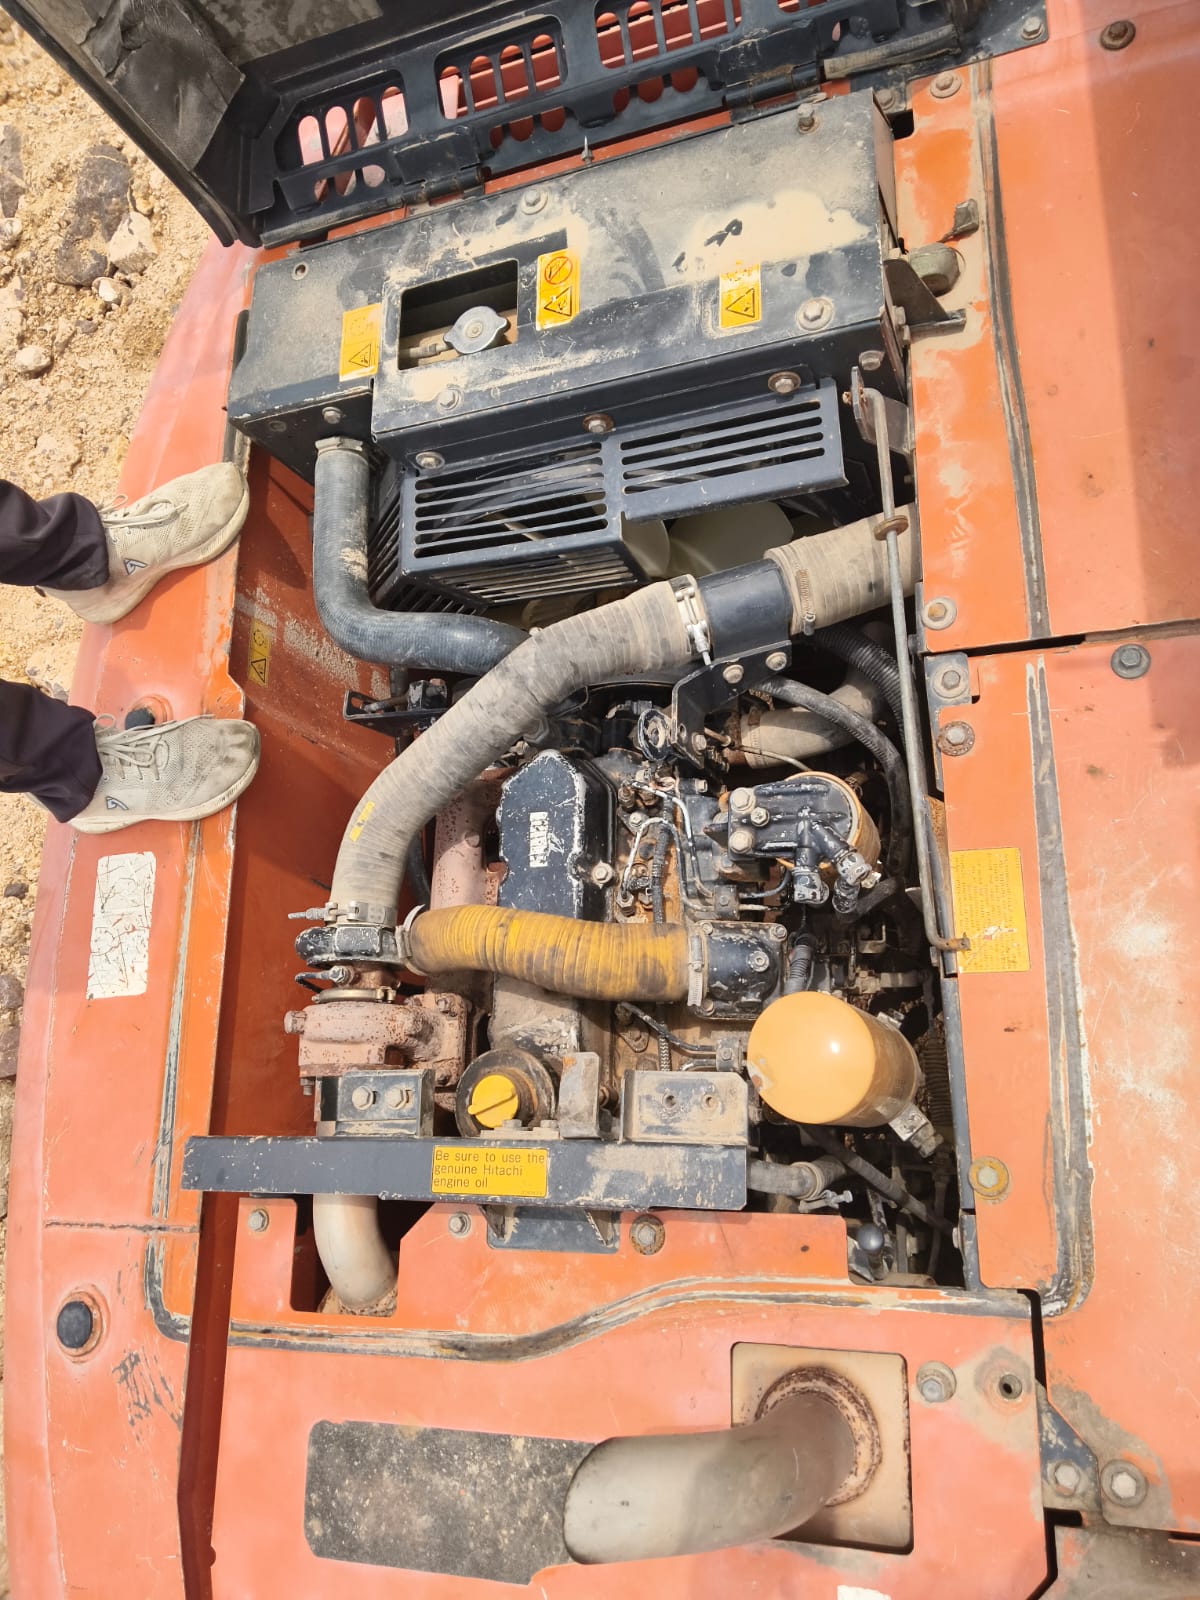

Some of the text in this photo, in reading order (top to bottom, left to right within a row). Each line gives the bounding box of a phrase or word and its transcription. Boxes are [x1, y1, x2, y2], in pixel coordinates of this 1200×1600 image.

[435, 1150, 545, 1163] Be sure to use the
[434, 1164, 523, 1176] genuine Hitachi
[433, 1177, 488, 1188] engine oil
